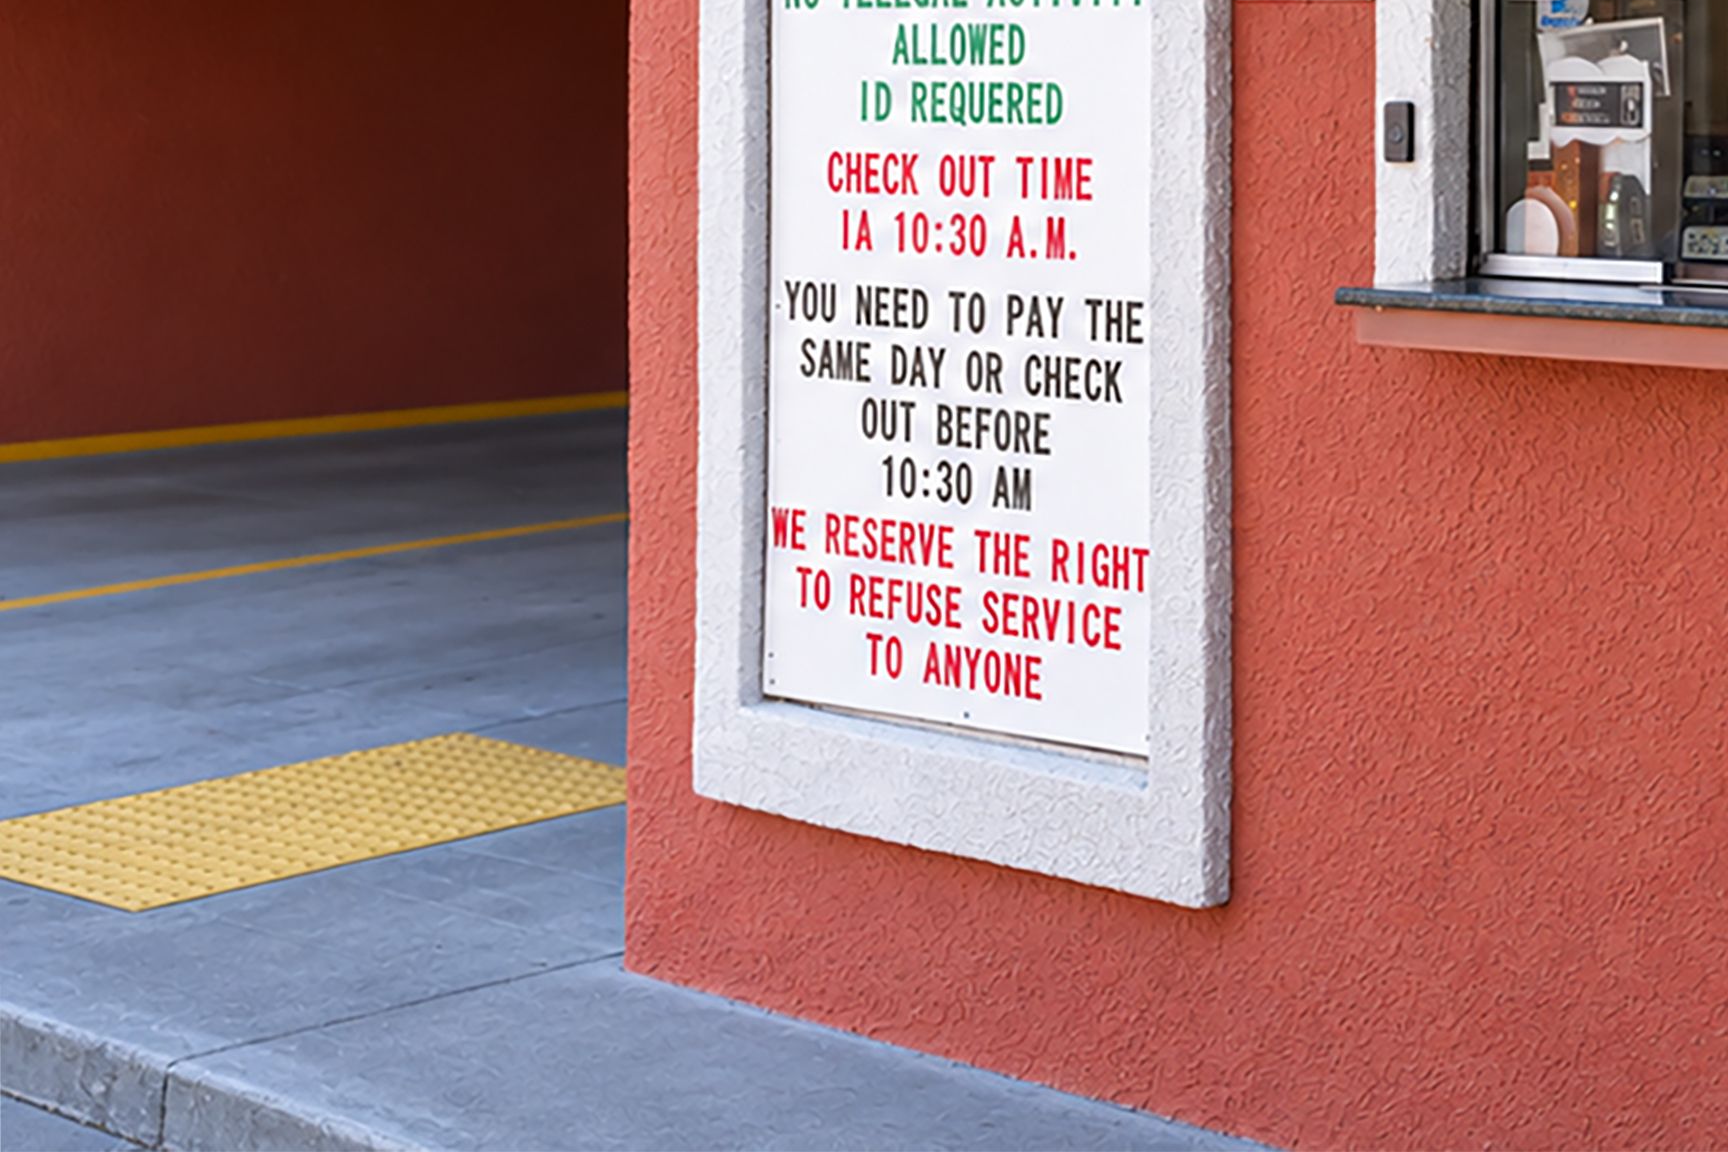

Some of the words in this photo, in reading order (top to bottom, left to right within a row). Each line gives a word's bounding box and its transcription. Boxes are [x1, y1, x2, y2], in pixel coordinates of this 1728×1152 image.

[893, 24, 1025, 65] ALLOWED
[862, 81, 891, 121] ID
[912, 82, 1062, 126] REQUERED
[828, 151, 918, 194] CHECK
[940, 155, 995, 197] OUT
[1016, 157, 1092, 200] TIME
[896, 212, 986, 256] 10:30
[1007, 216, 1076, 260] A.M.
[785, 281, 835, 322] YOU
[856, 286, 928, 329] NEED
[949, 292, 985, 333] TO
[1007, 295, 1063, 338] PAY
[1085, 299, 1143, 344] THE
[801, 338, 870, 382] SAME
[892, 345, 945, 388] DAY
[967, 351, 1002, 393] OR
[1025, 355, 1122, 403] CHECK
[862, 398, 915, 442] OUT
[937, 404, 1050, 455] BEFORE
[883, 456, 971, 504] 10:30
[993, 466, 1030, 510] AM
[772, 507, 806, 550] WE
[826, 513, 953, 568] RESERVE
[975, 530, 1030, 577] THE
[1052, 539, 1149, 592] RIGHT
[797, 567, 830, 610] TO
[850, 574, 961, 628] REFUSE
[982, 591, 1121, 650] SERVICE
[866, 633, 902, 679] TO
[924, 642, 1042, 700] ANYONE
